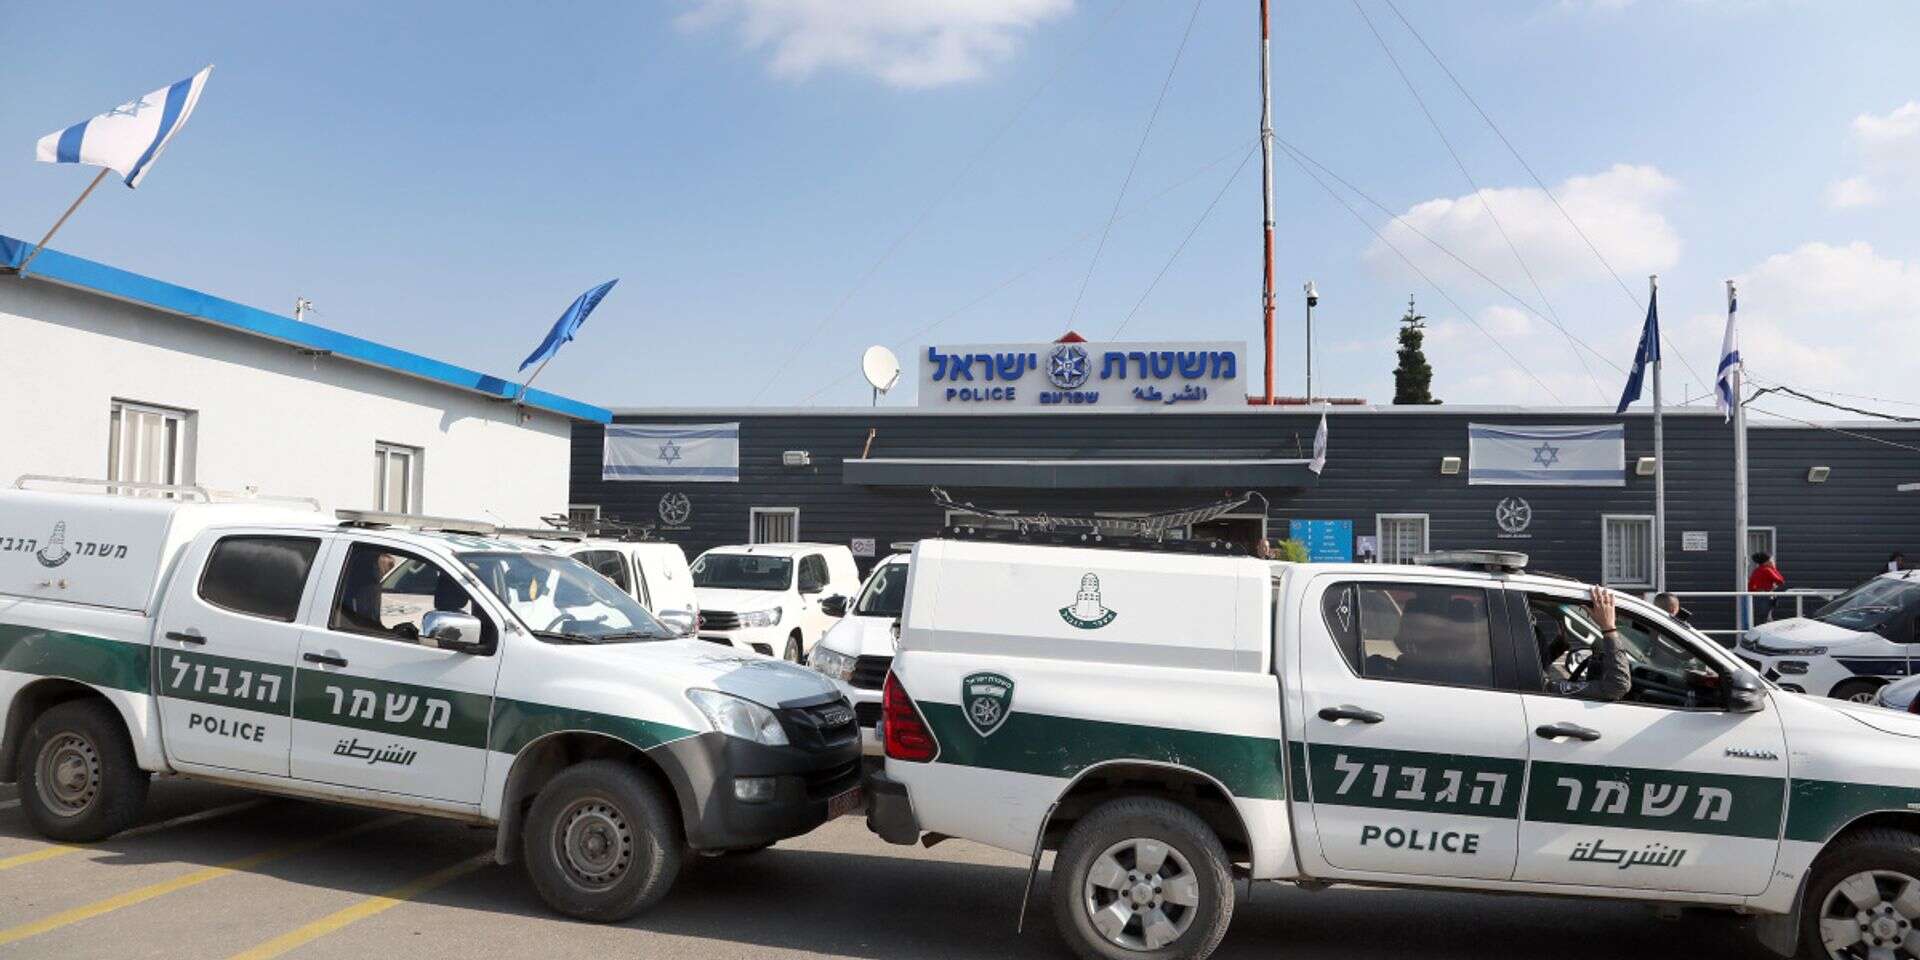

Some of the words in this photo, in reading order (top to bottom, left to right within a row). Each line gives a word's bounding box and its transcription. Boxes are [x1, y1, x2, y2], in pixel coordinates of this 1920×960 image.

[928, 346, 1038, 381] ישראל
[1100, 351, 1236, 380] משטרת
[946, 386, 1016, 402] POLICE
[1039, 391, 1099, 404] שפרעם
[75, 541, 128, 559] משמר
[169, 655, 282, 703] הגבול
[325, 684, 452, 730] משמר
[188, 713, 266, 743] POLICE
[333, 738, 418, 766] الشرطة
[1333, 753, 1507, 807] הגבול
[1556, 776, 1734, 823] משמר
[1360, 825, 1480, 855] POLICE
[1569, 839, 1687, 870] الشرطة
